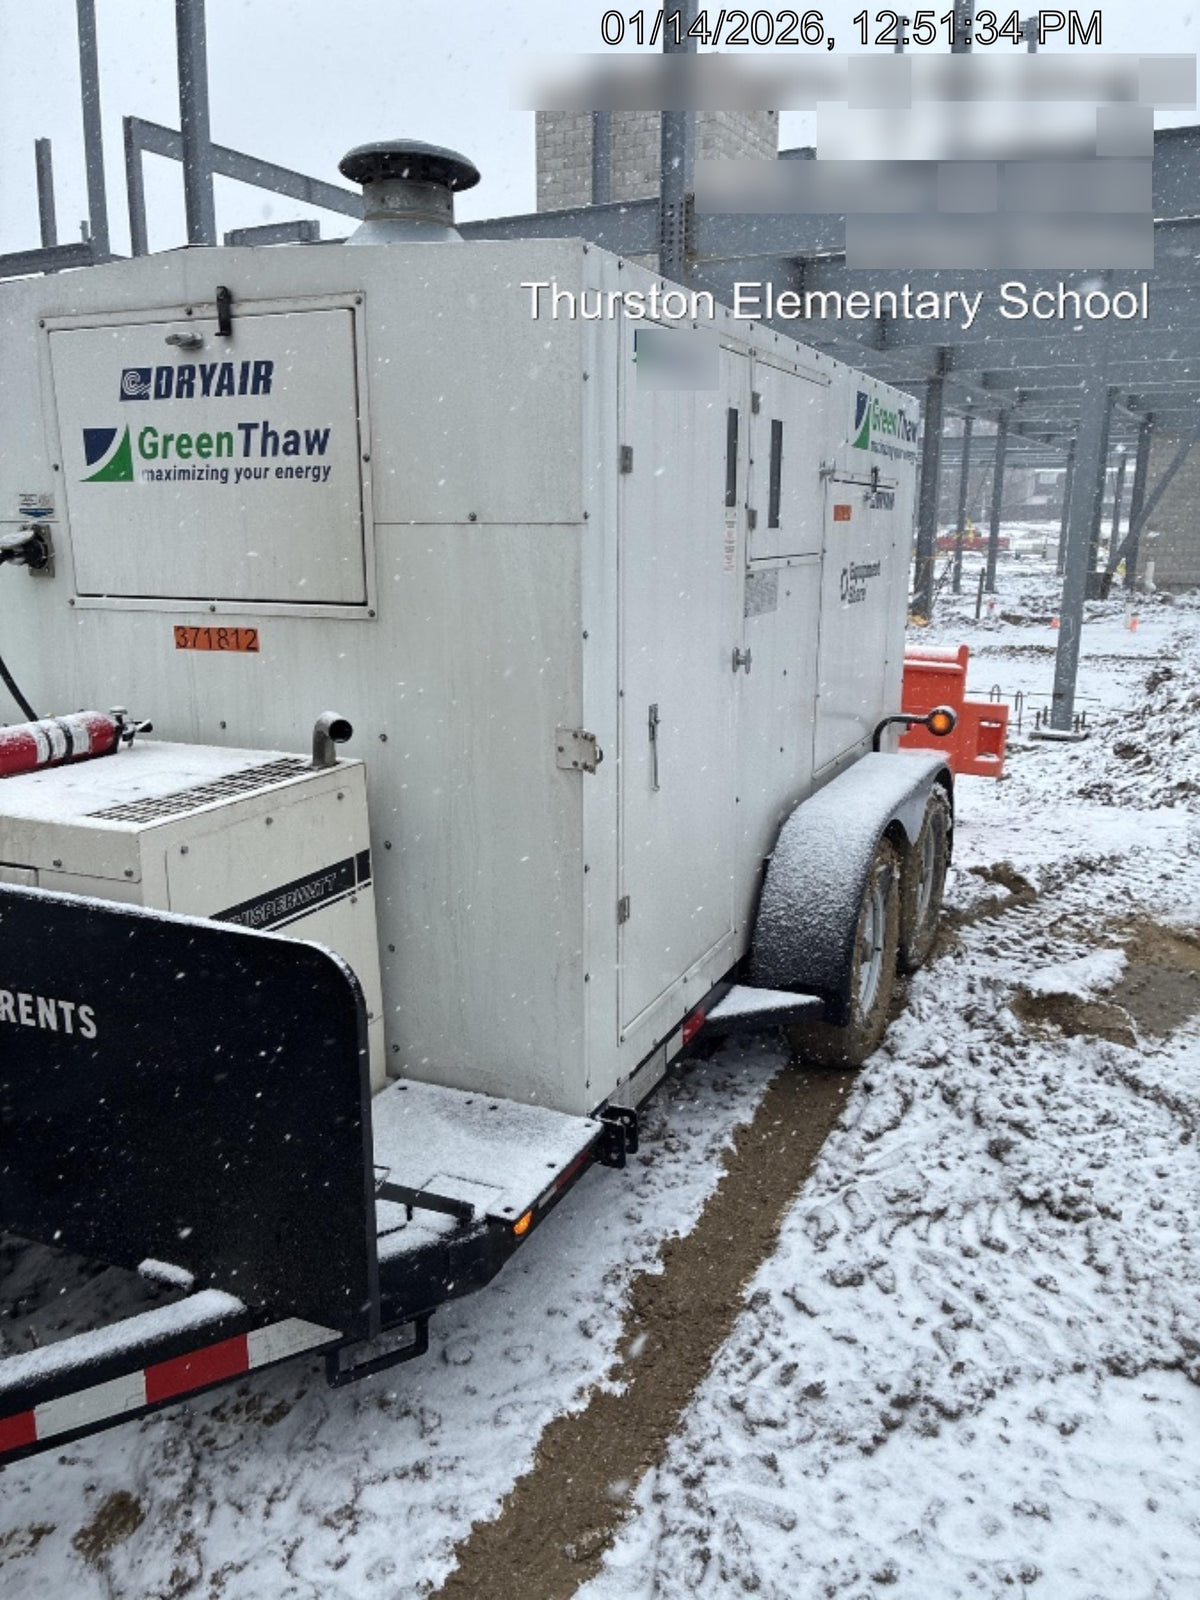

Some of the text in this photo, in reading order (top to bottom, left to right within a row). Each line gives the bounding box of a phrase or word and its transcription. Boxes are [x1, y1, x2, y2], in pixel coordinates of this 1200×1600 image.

[153, 360, 274, 400] DRYAIR
[142, 464, 332, 484] maximizing your energy
[175, 626, 259, 652] 371812
[0, 989, 98, 1039] RENTS
